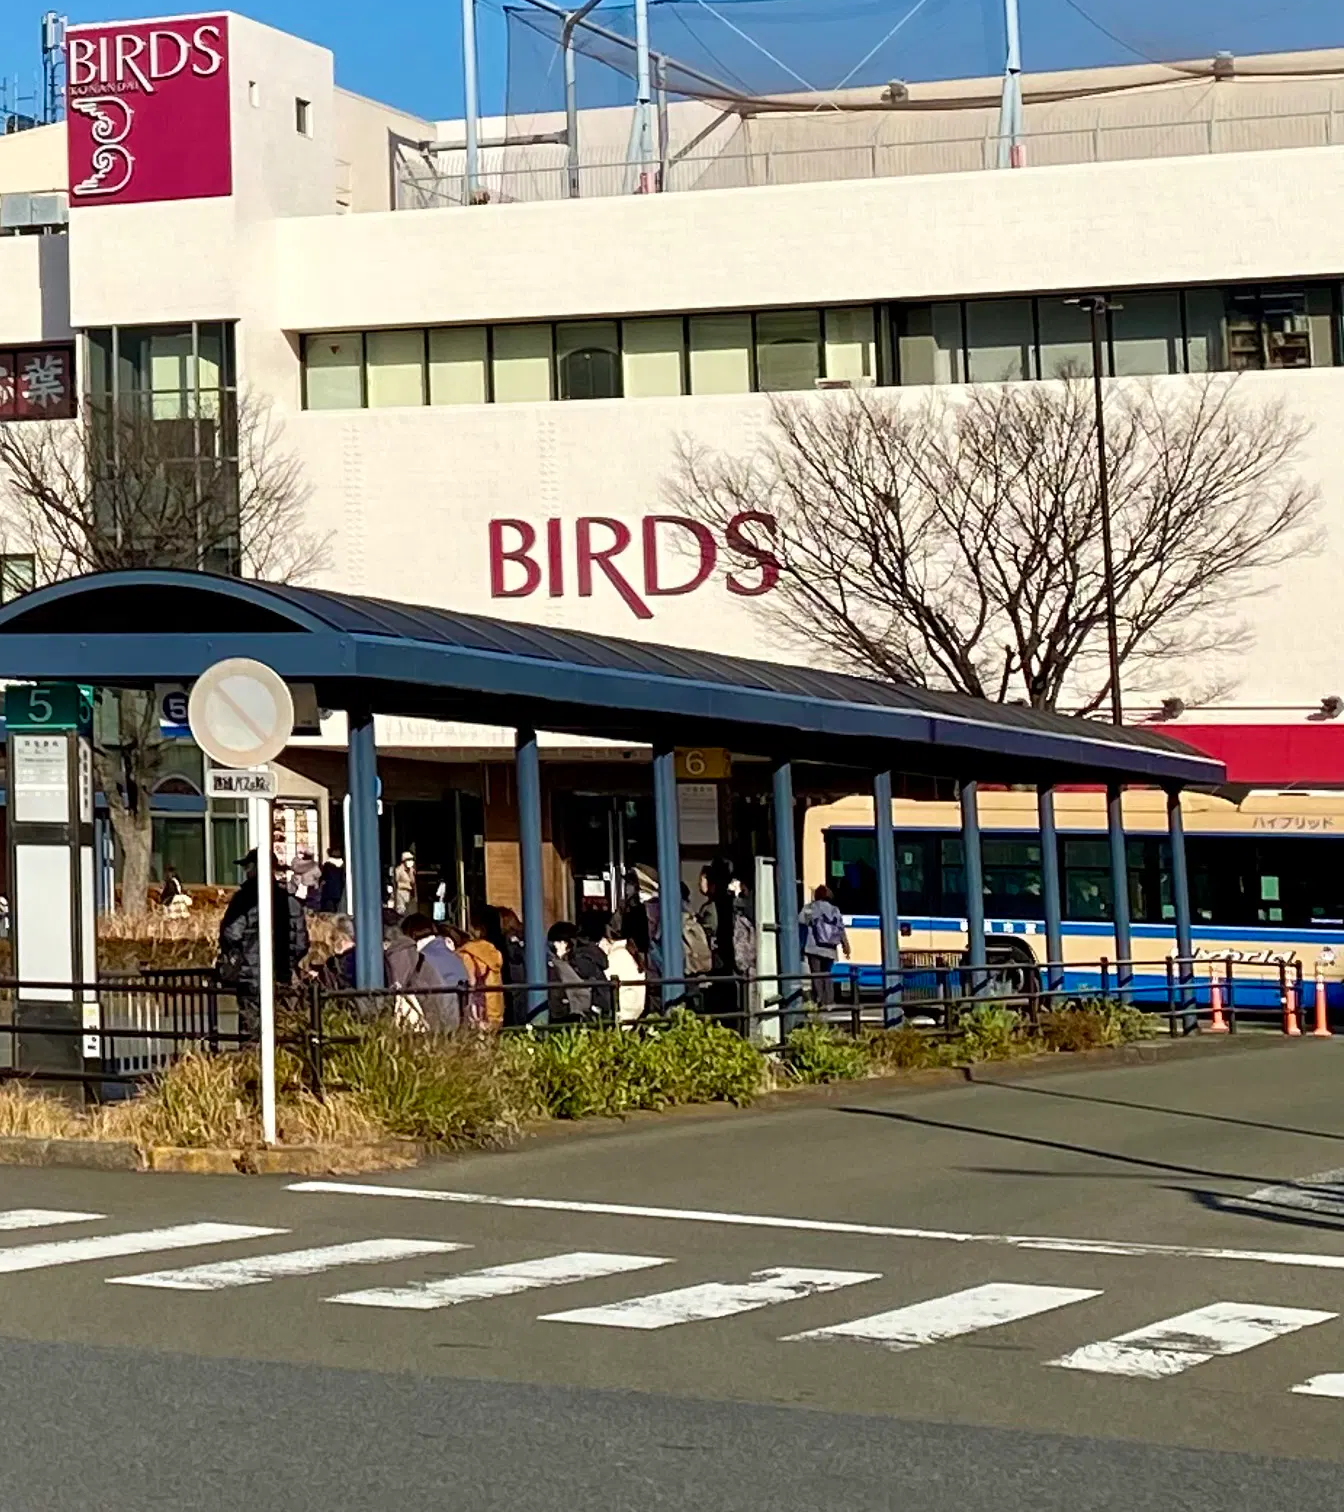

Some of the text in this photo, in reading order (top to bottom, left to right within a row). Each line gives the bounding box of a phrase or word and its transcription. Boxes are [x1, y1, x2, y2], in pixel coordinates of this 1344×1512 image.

[69, 25, 223, 92] BIRDS
[488, 510, 781, 620] BIRDS
[27, 689, 53, 723] 5
[168, 698, 187, 720] 5
[685, 750, 705, 775] 6
[1252, 817, 1335, 830] ハイブリッド
